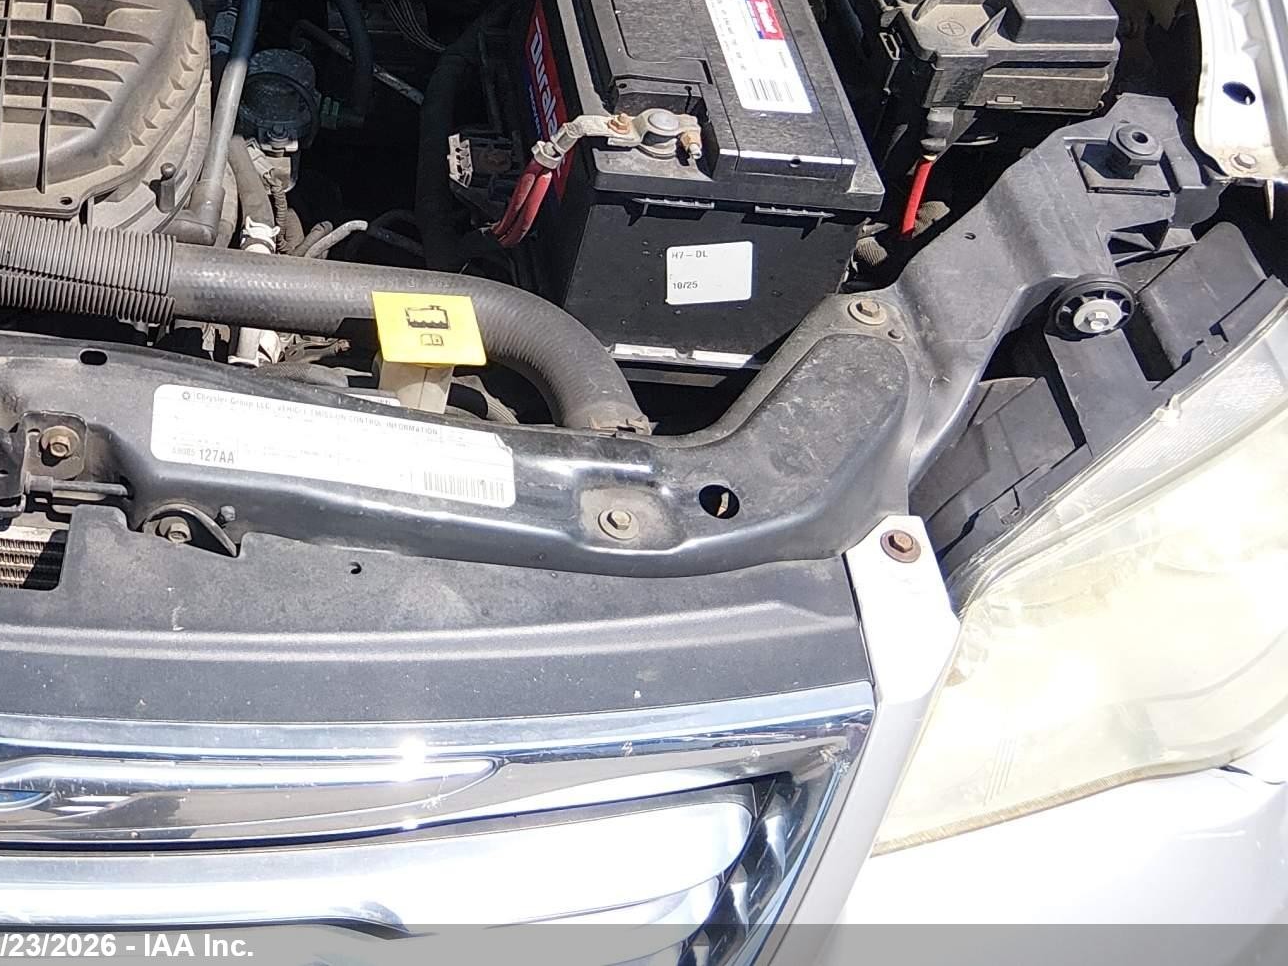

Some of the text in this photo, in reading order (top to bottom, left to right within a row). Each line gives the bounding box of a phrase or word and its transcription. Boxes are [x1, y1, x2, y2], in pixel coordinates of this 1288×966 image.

[672, 280, 698, 290] 10/25
[196, 392, 228, 403] Chrysler
[386, 421, 439, 436] INFORMATION
[199, 447, 235, 465] 127AA
